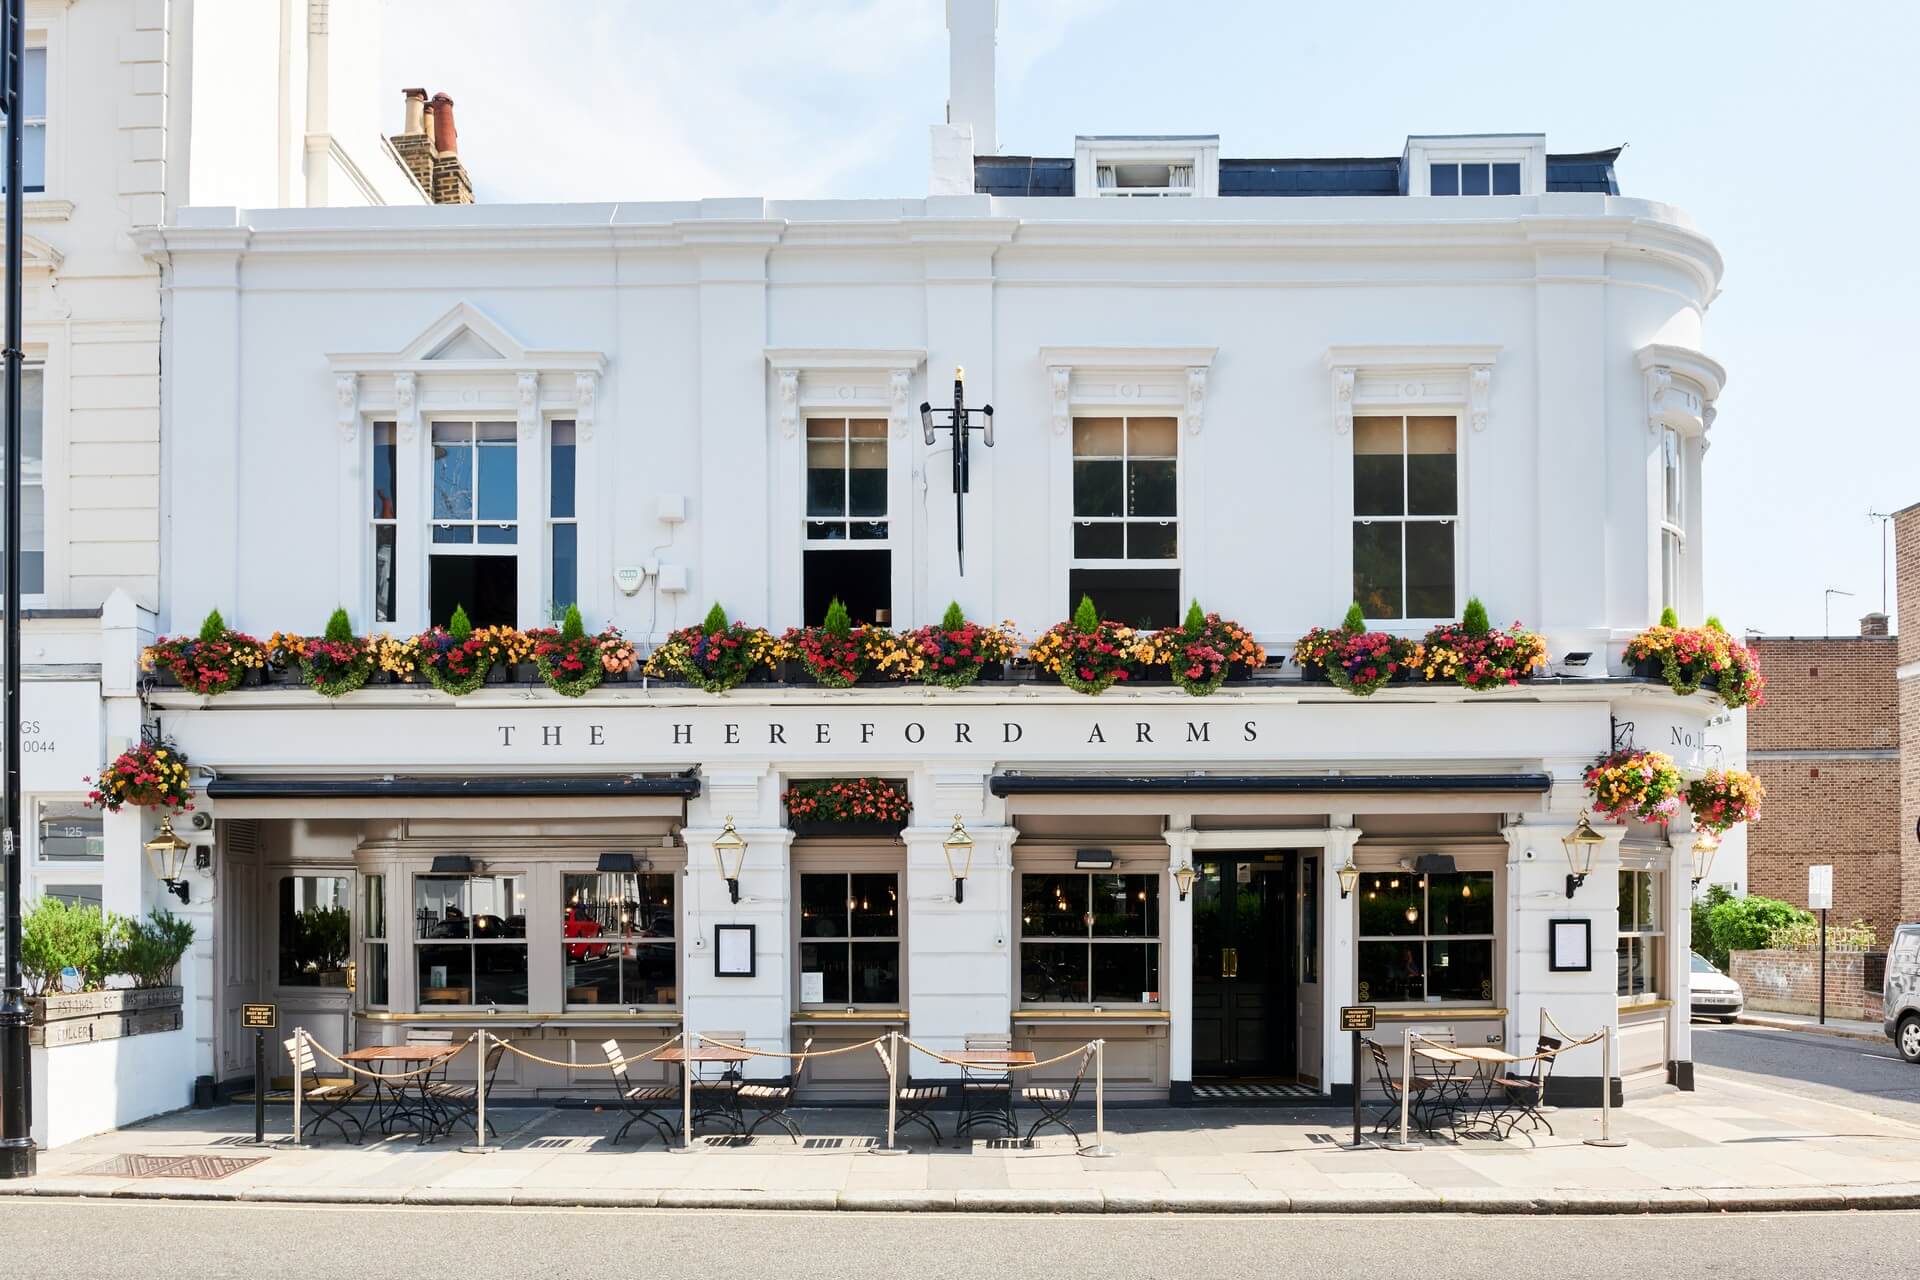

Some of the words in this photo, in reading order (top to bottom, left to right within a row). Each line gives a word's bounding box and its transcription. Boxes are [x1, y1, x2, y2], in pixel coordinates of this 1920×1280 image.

[498, 725, 605, 747] THE
[672, 723, 1023, 745] HEREFORD
[1087, 721, 1257, 743] ARMS
[23, 740, 55, 752] 0044
[64, 827, 82, 837] 125
